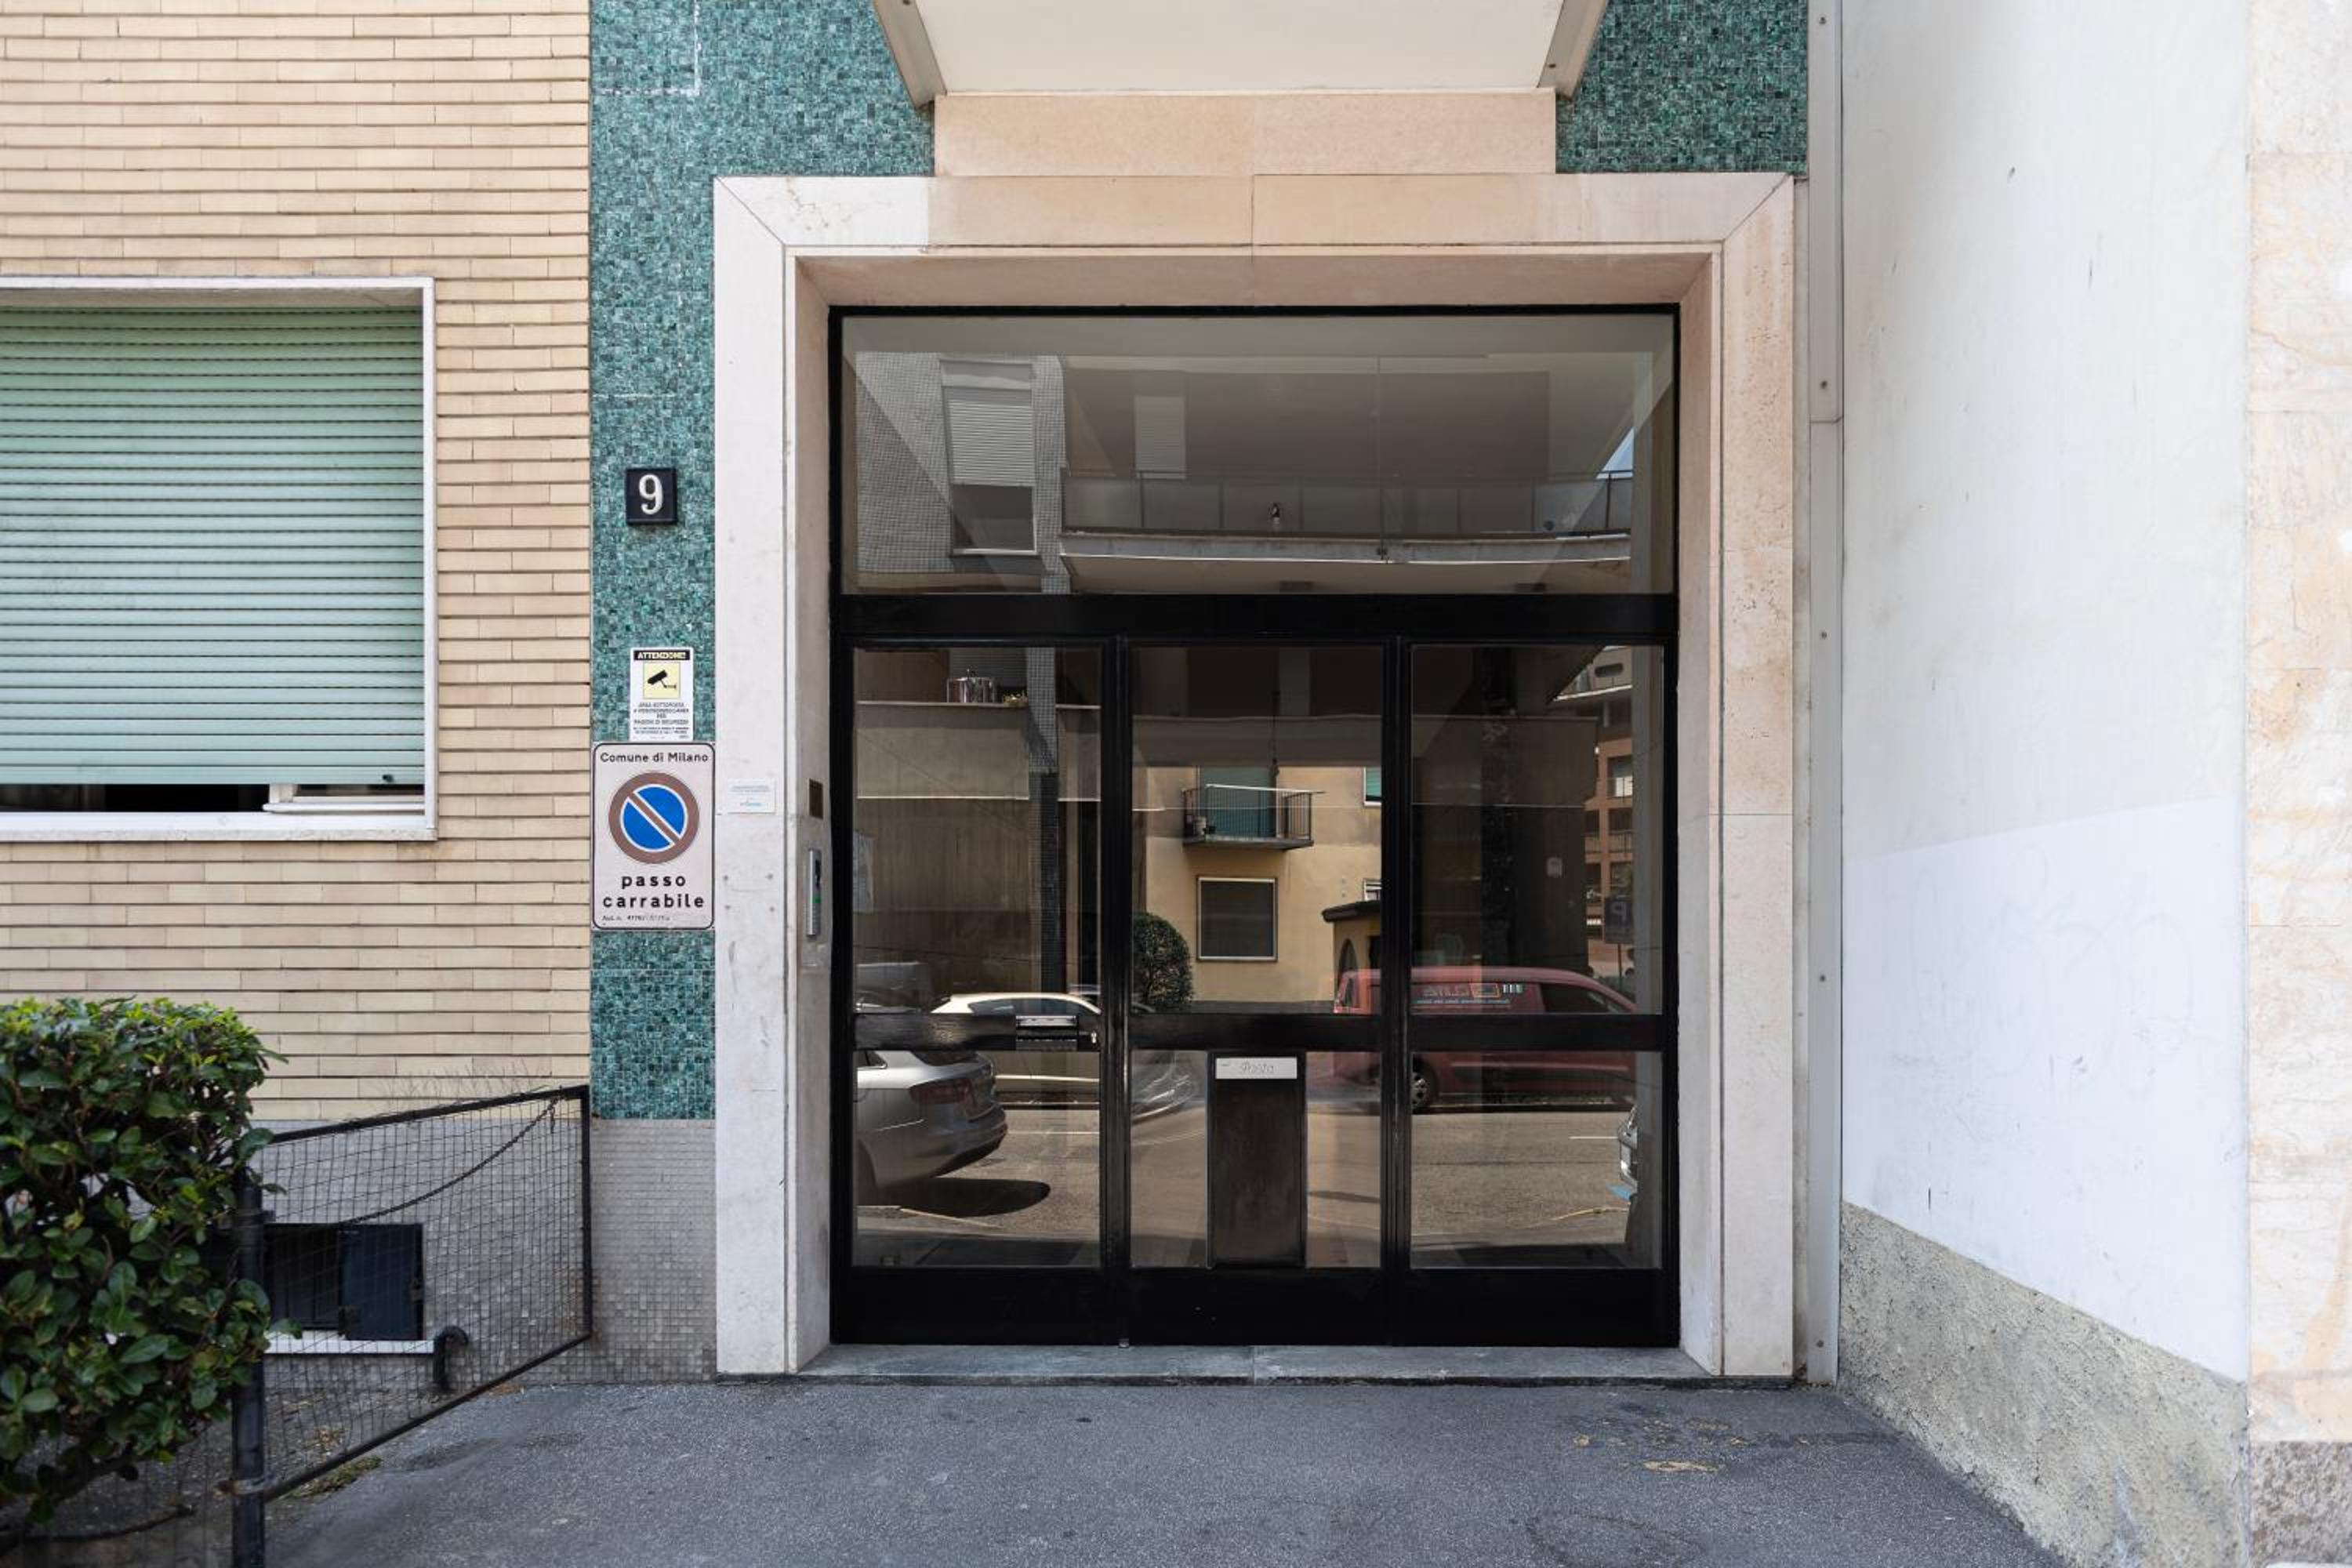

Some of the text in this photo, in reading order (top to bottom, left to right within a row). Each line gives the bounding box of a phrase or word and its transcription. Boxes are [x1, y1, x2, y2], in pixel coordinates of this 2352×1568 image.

[639, 474, 663, 515] 9
[600, 752, 709, 763] Comune di Milano
[622, 876, 686, 889] passo
[603, 894, 705, 908] carrabile
